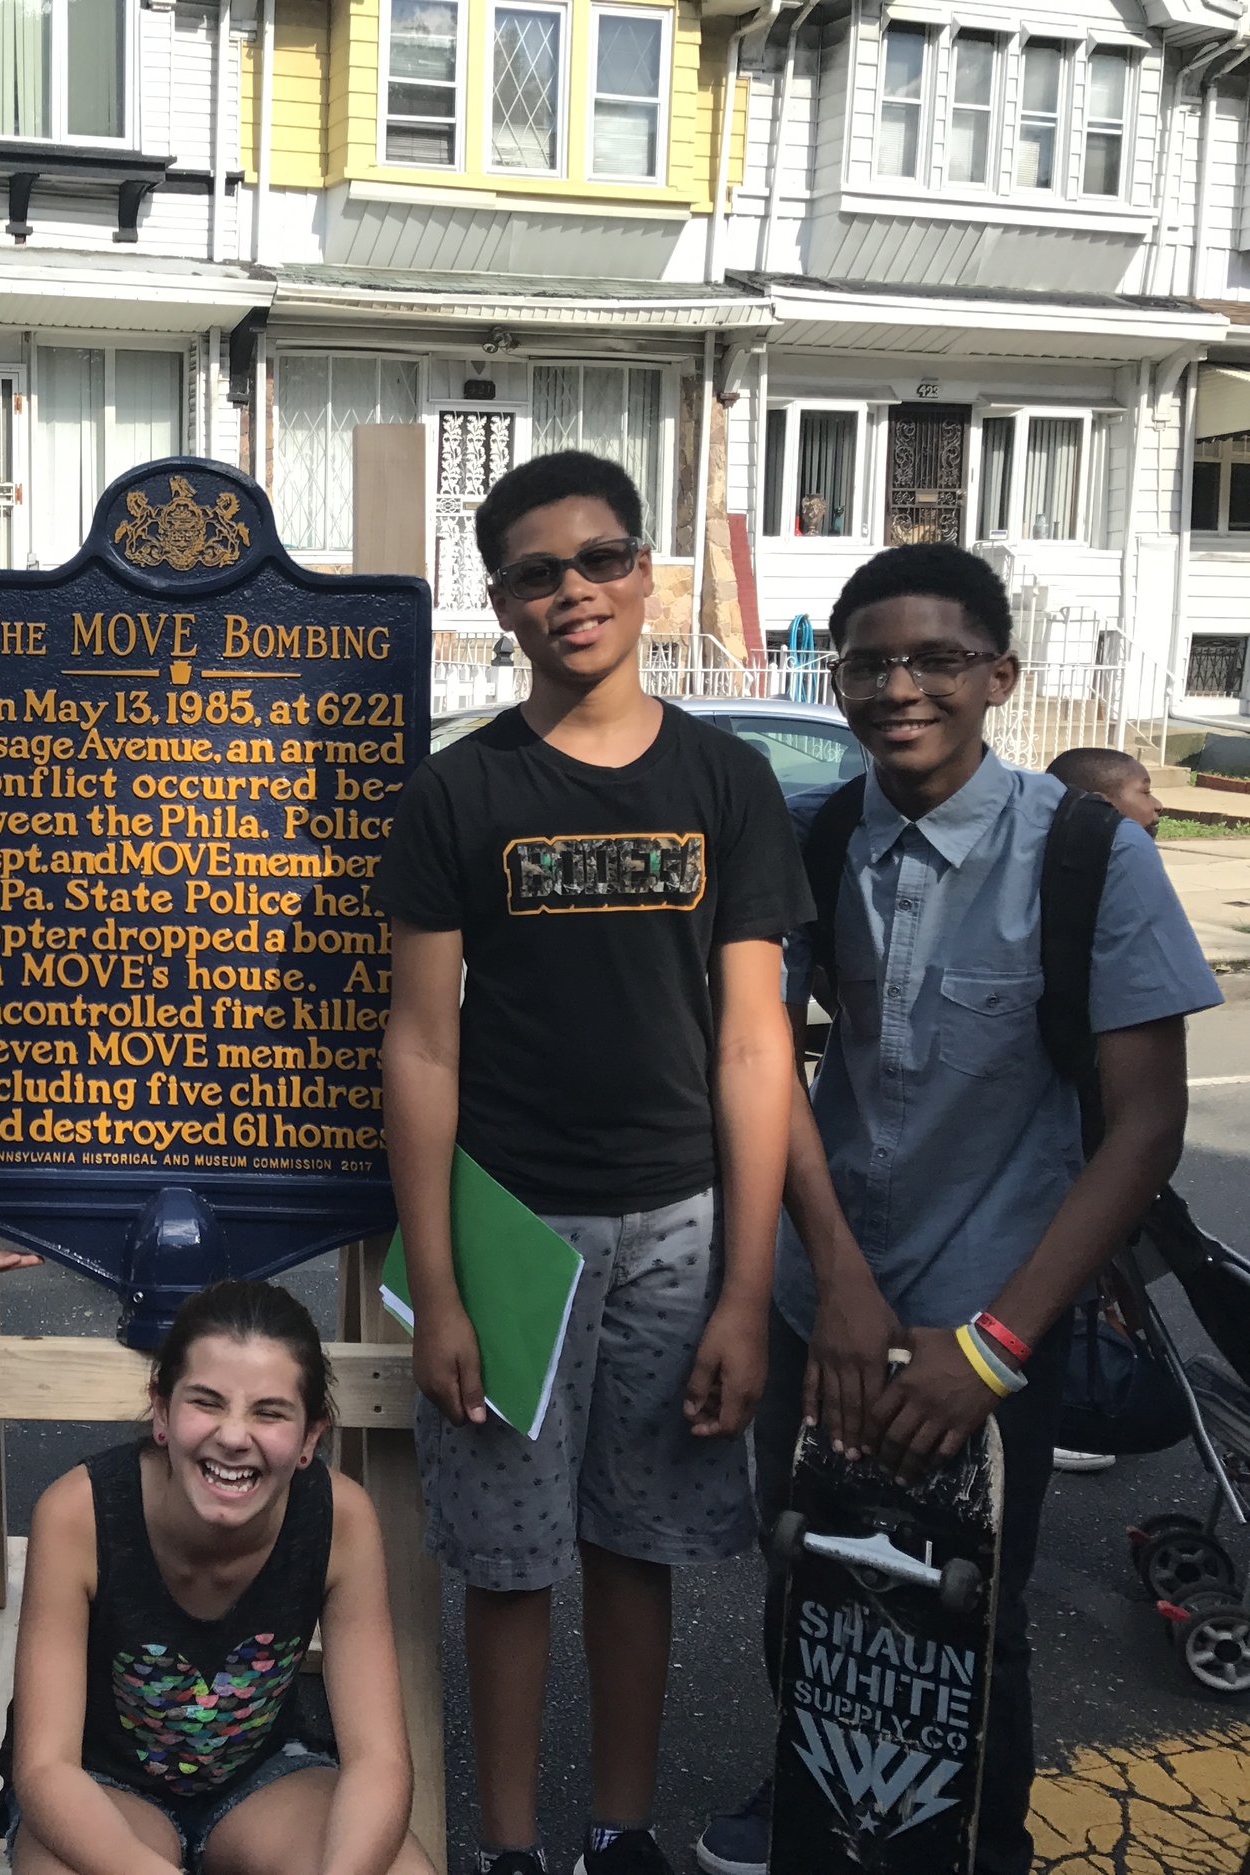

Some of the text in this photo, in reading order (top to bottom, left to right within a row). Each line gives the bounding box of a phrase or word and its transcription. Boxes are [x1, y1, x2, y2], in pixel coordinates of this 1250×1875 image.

[73, 612, 198, 658] MOVE
[23, 688, 108, 732] May
[115, 690, 160, 725] 13,
[165, 689, 263, 728] 1985,
[268, 694, 310, 726] at
[315, 692, 404, 727] 6221
[77, 727, 223, 765] Avenue,
[225, 738, 276, 765] an
[279, 732, 404, 765] armed
[131, 767, 318, 802] occurred
[85, 804, 154, 838] the
[158, 804, 270, 840] Phila.
[283, 807, 392, 841] Police
[49, 841, 119, 876] and
[119, 839, 233, 878] MOVE
[0, 876, 55, 912] Pa.
[64, 879, 174, 914] State
[185, 879, 303, 917] Police
[90, 917, 260, 961] dropped
[262, 928, 287, 954] a
[293, 921, 390, 954] bomb
[21, 952, 170, 990] MOVE's
[185, 957, 316, 993] house.
[211, 996, 286, 1030] fire
[87, 1031, 209, 1069] MOVE
[146, 1071, 223, 1107] five
[28, 1108, 228, 1153] destroyed
[232, 1111, 269, 1148] 61
[82, 1153, 156, 1165] HISTORICAL
[163, 1154, 189, 1166] AND
[194, 1155, 247, 1168] MUSEUM
[253, 1157, 332, 1170] COMMISSION
[342, 1159, 373, 1172] 2017
[799, 1600, 975, 1686] SHAUN
[799, 1637, 972, 1729] WHITE
[794, 1680, 912, 1740] SUPPLY
